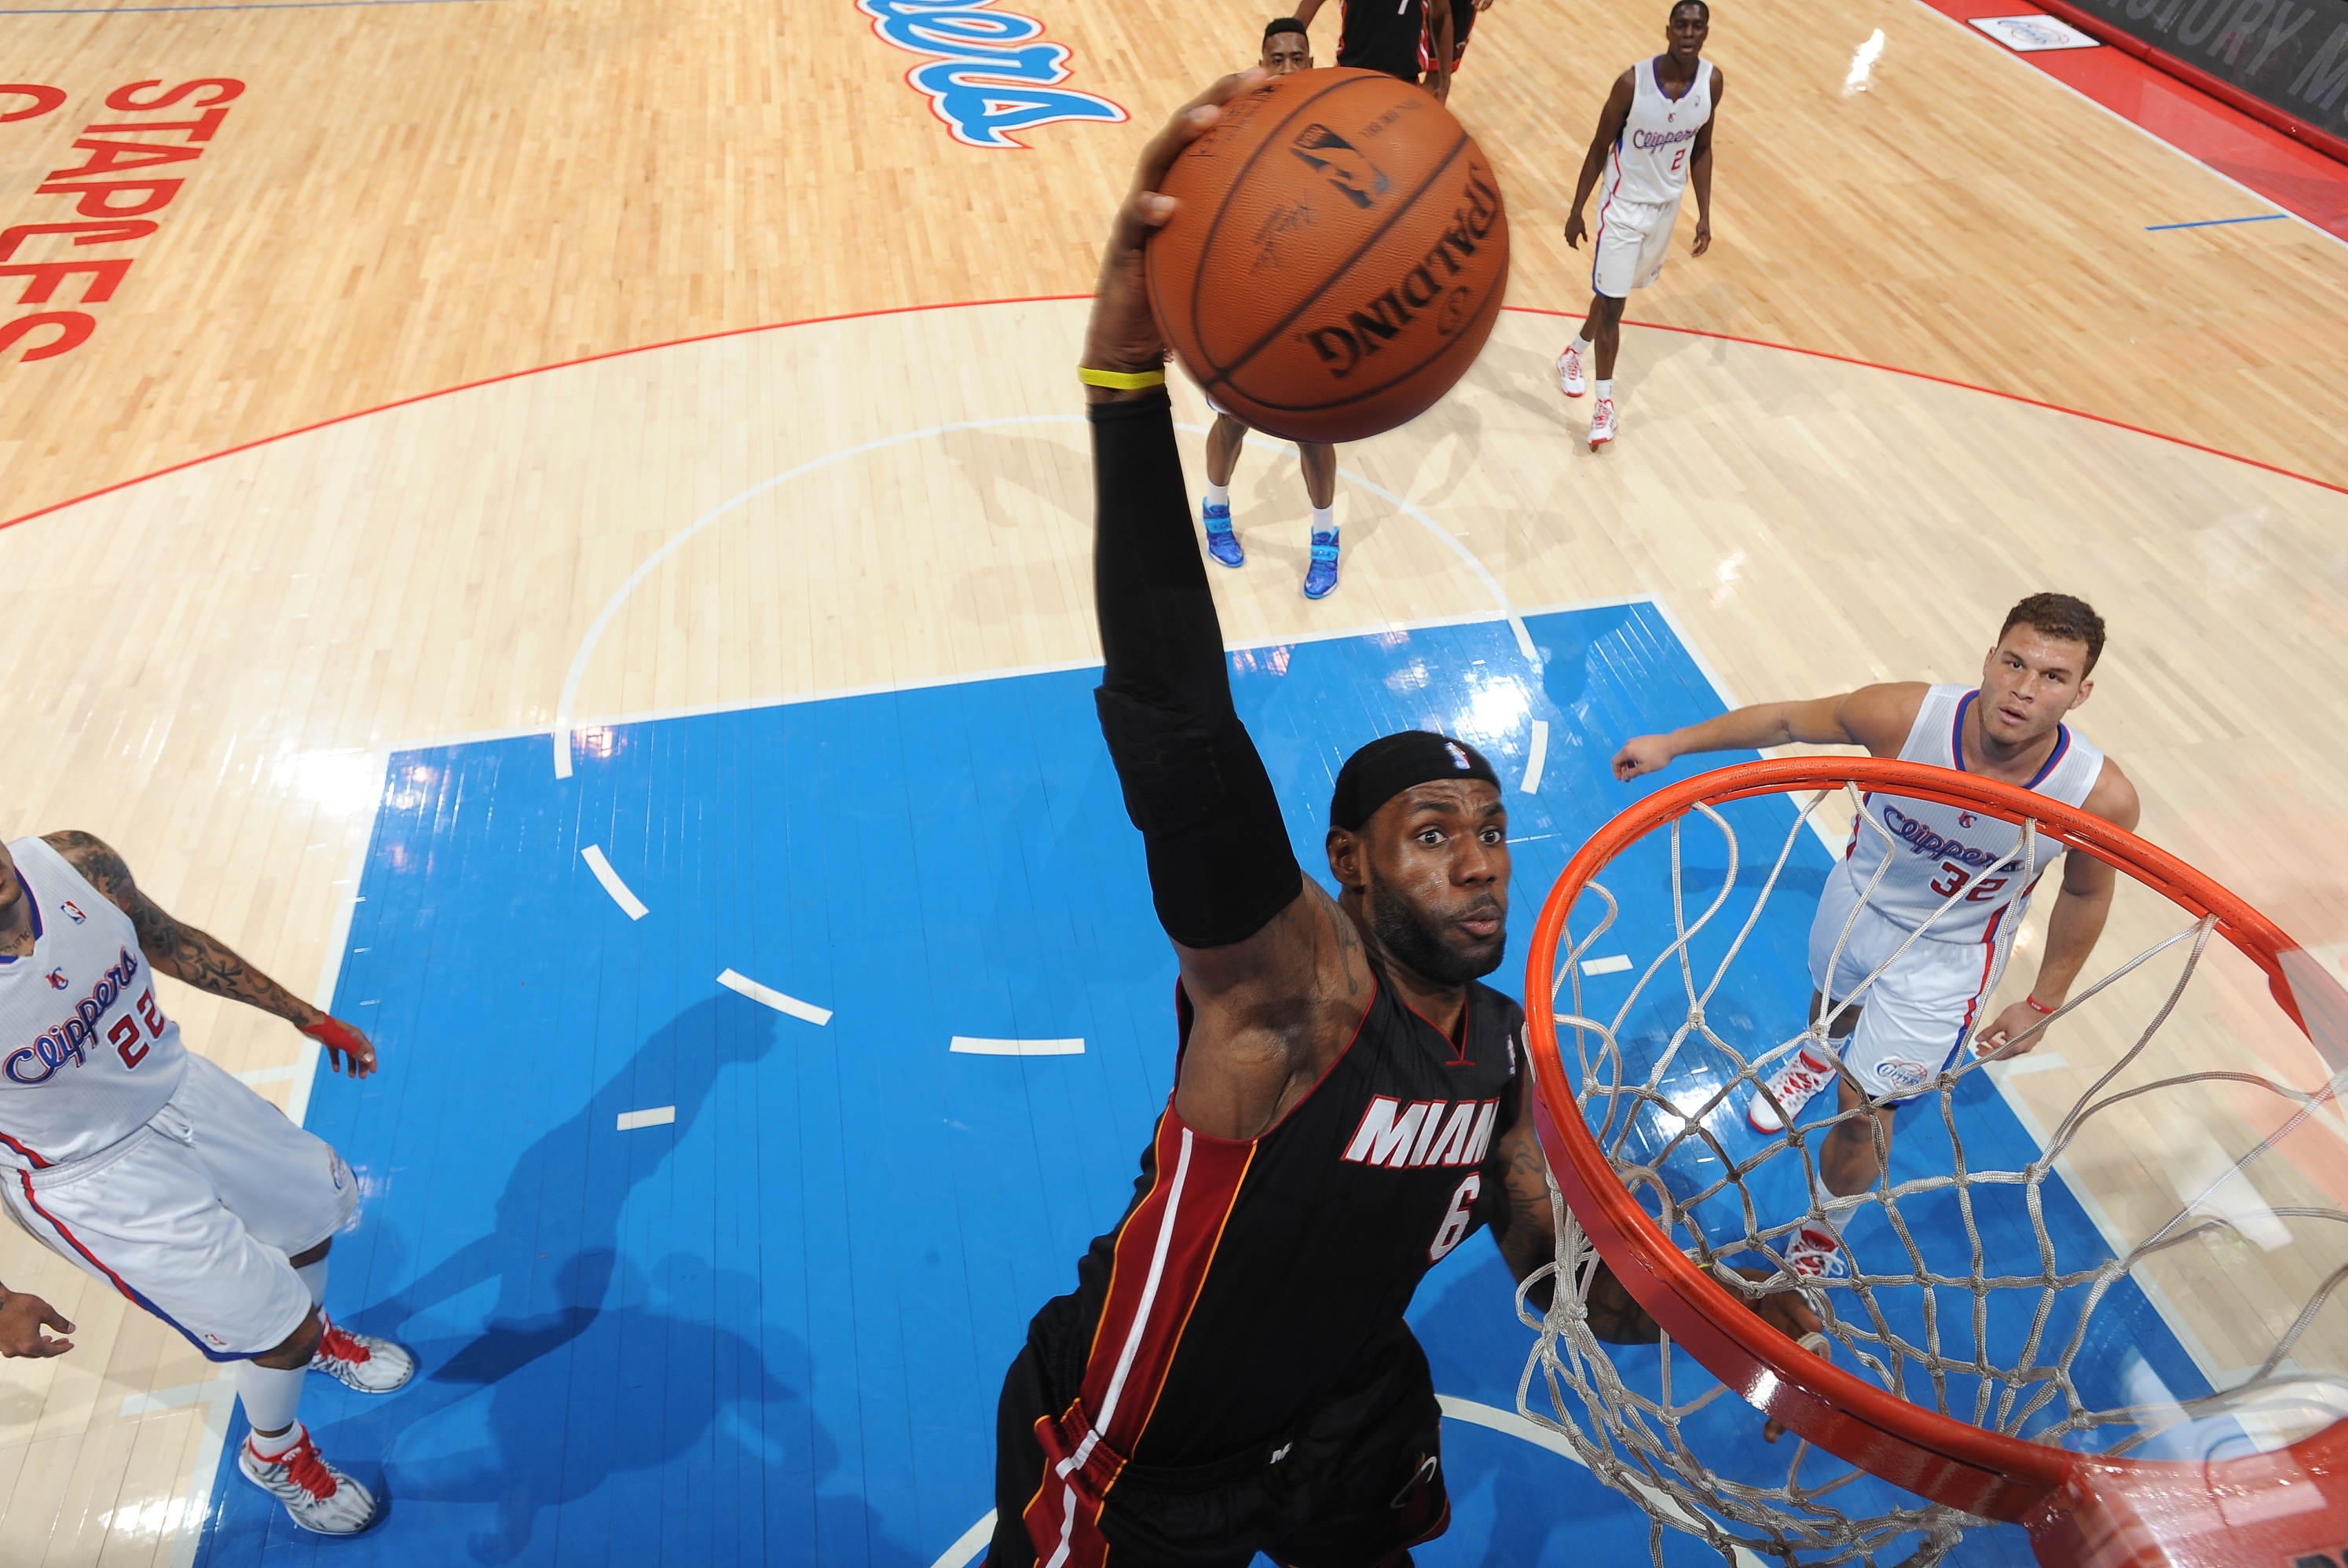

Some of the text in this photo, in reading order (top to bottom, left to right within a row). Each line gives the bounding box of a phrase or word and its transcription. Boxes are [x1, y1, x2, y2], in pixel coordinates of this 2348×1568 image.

[1671, 148, 1687, 170] 2
[1929, 860, 2009, 903] 32
[2, 947, 138, 1084] Clippers
[107, 987, 165, 1071] 22
[1427, 1171, 1481, 1262] 6
